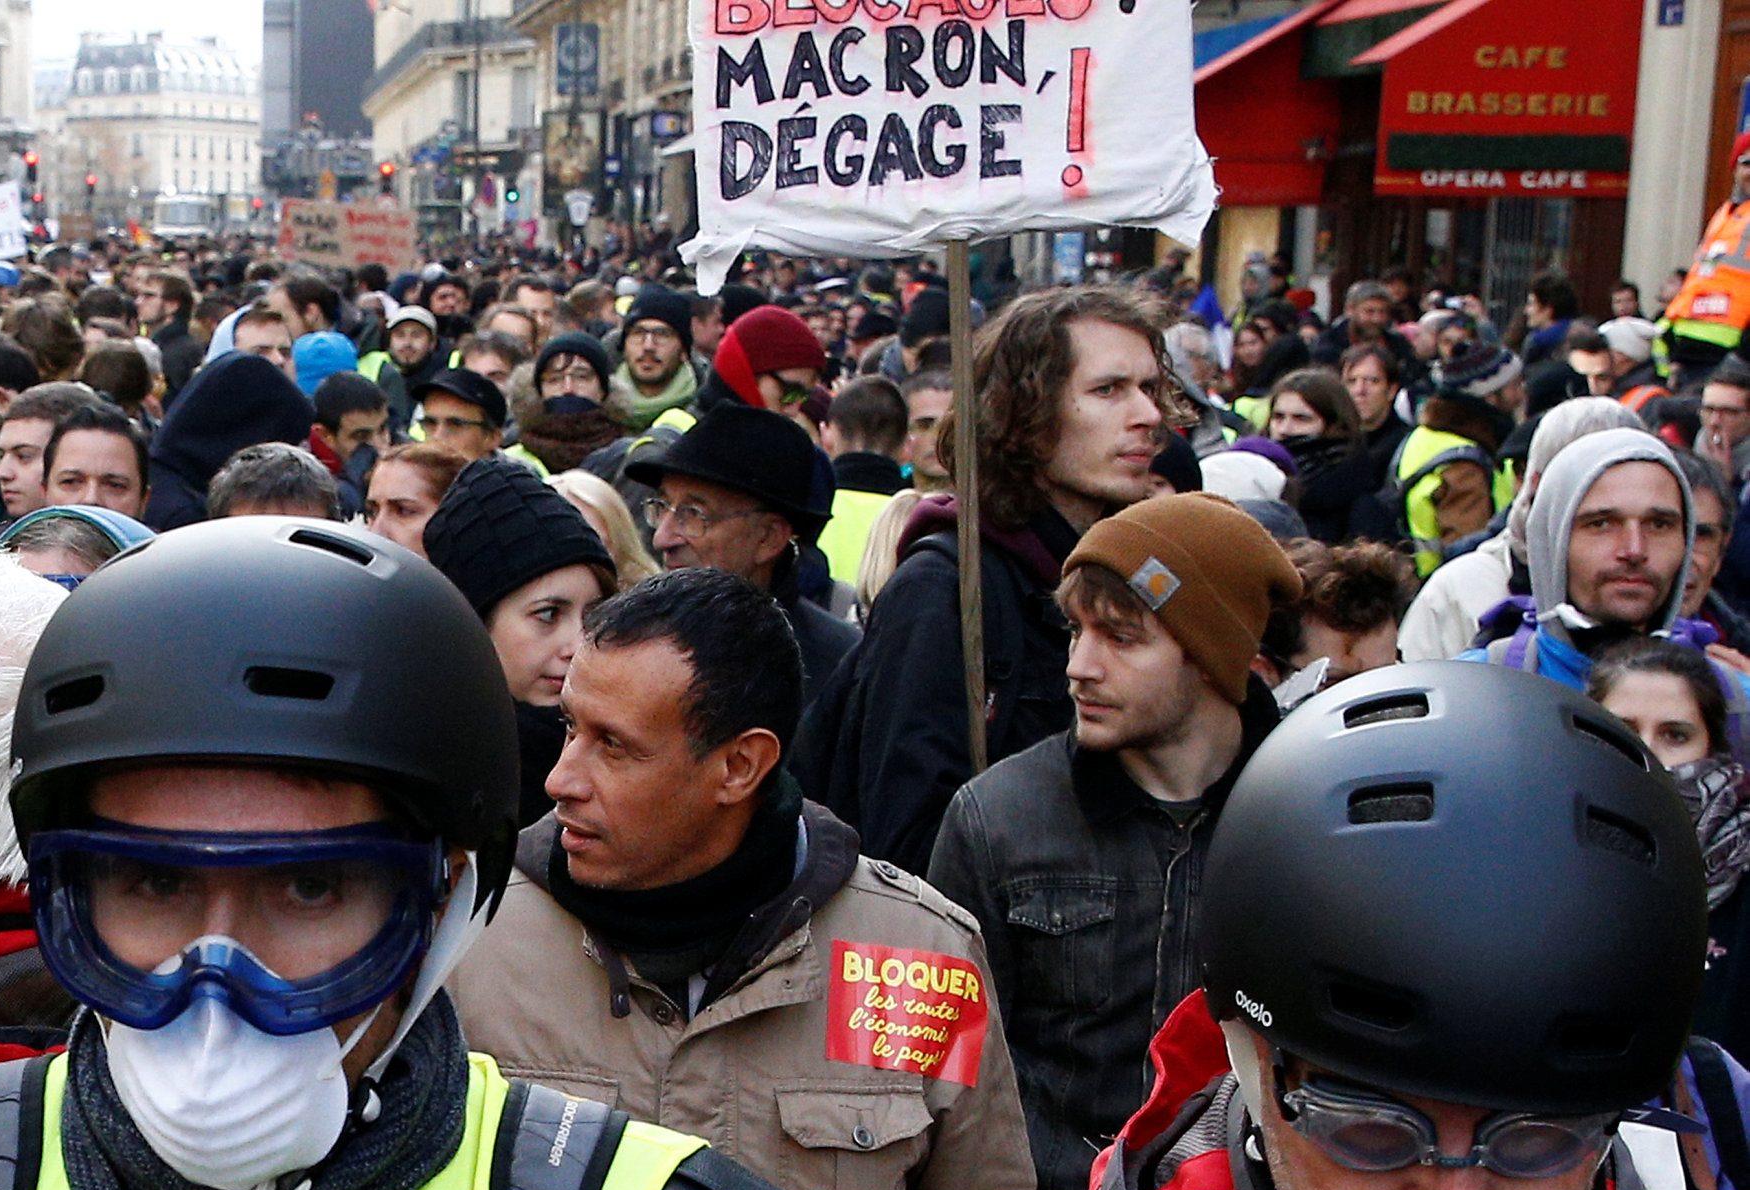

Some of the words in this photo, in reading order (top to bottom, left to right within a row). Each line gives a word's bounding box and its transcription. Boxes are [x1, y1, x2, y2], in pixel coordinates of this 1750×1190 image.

[716, 20, 1057, 108] MACRON,
[1474, 46, 1568, 69] CAFE
[1406, 91, 1610, 117] BRASSERIE
[721, 103, 1023, 201] DÉGAGE
[1420, 170, 1506, 188] OPERA
[1519, 171, 1587, 189] CAFE
[842, 950, 980, 1003] BLOQUER
[863, 985, 898, 1010] les
[1235, 990, 1273, 1027] oxelo
[872, 1034, 895, 1057] le
